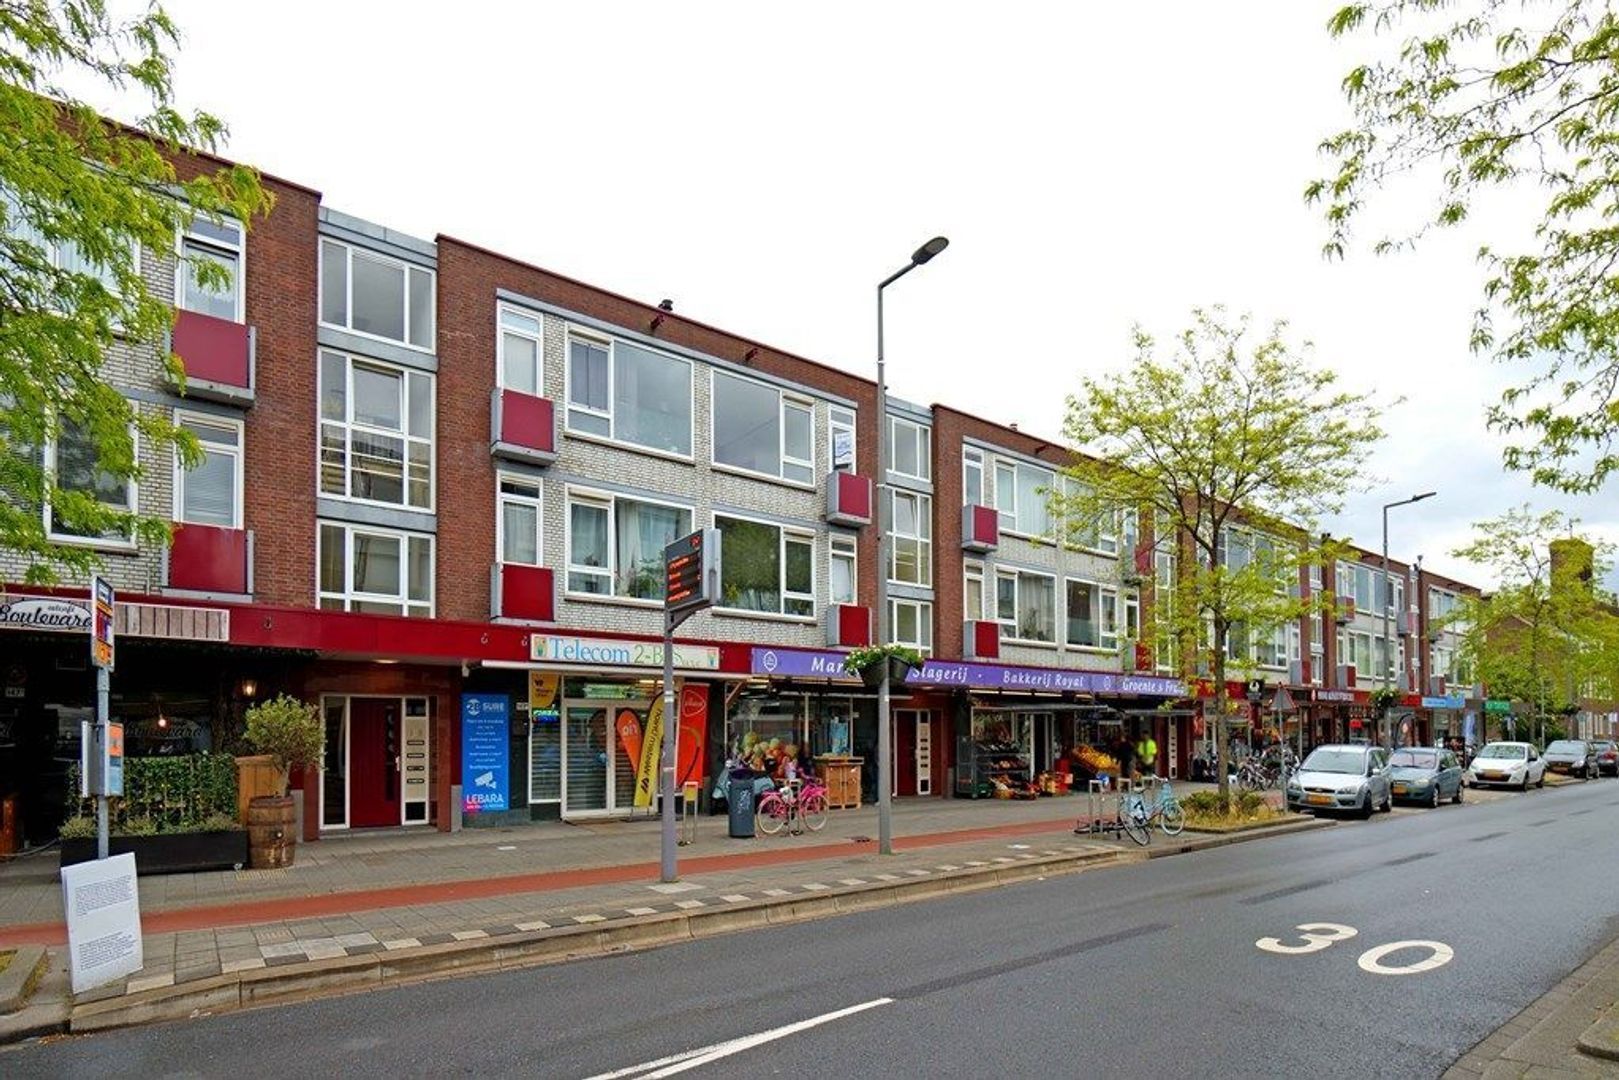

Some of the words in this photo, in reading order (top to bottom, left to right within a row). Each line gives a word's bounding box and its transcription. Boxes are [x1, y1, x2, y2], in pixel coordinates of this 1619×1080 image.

[549, 637, 631, 664] Telecom
[1002, 670, 1051, 687] Bakkerij
[1054, 673, 1084, 689] Royal
[1122, 679, 1157, 693] Groente
[466, 794, 504, 804] LEBARA
[1255, 922, 1454, 975] 30
